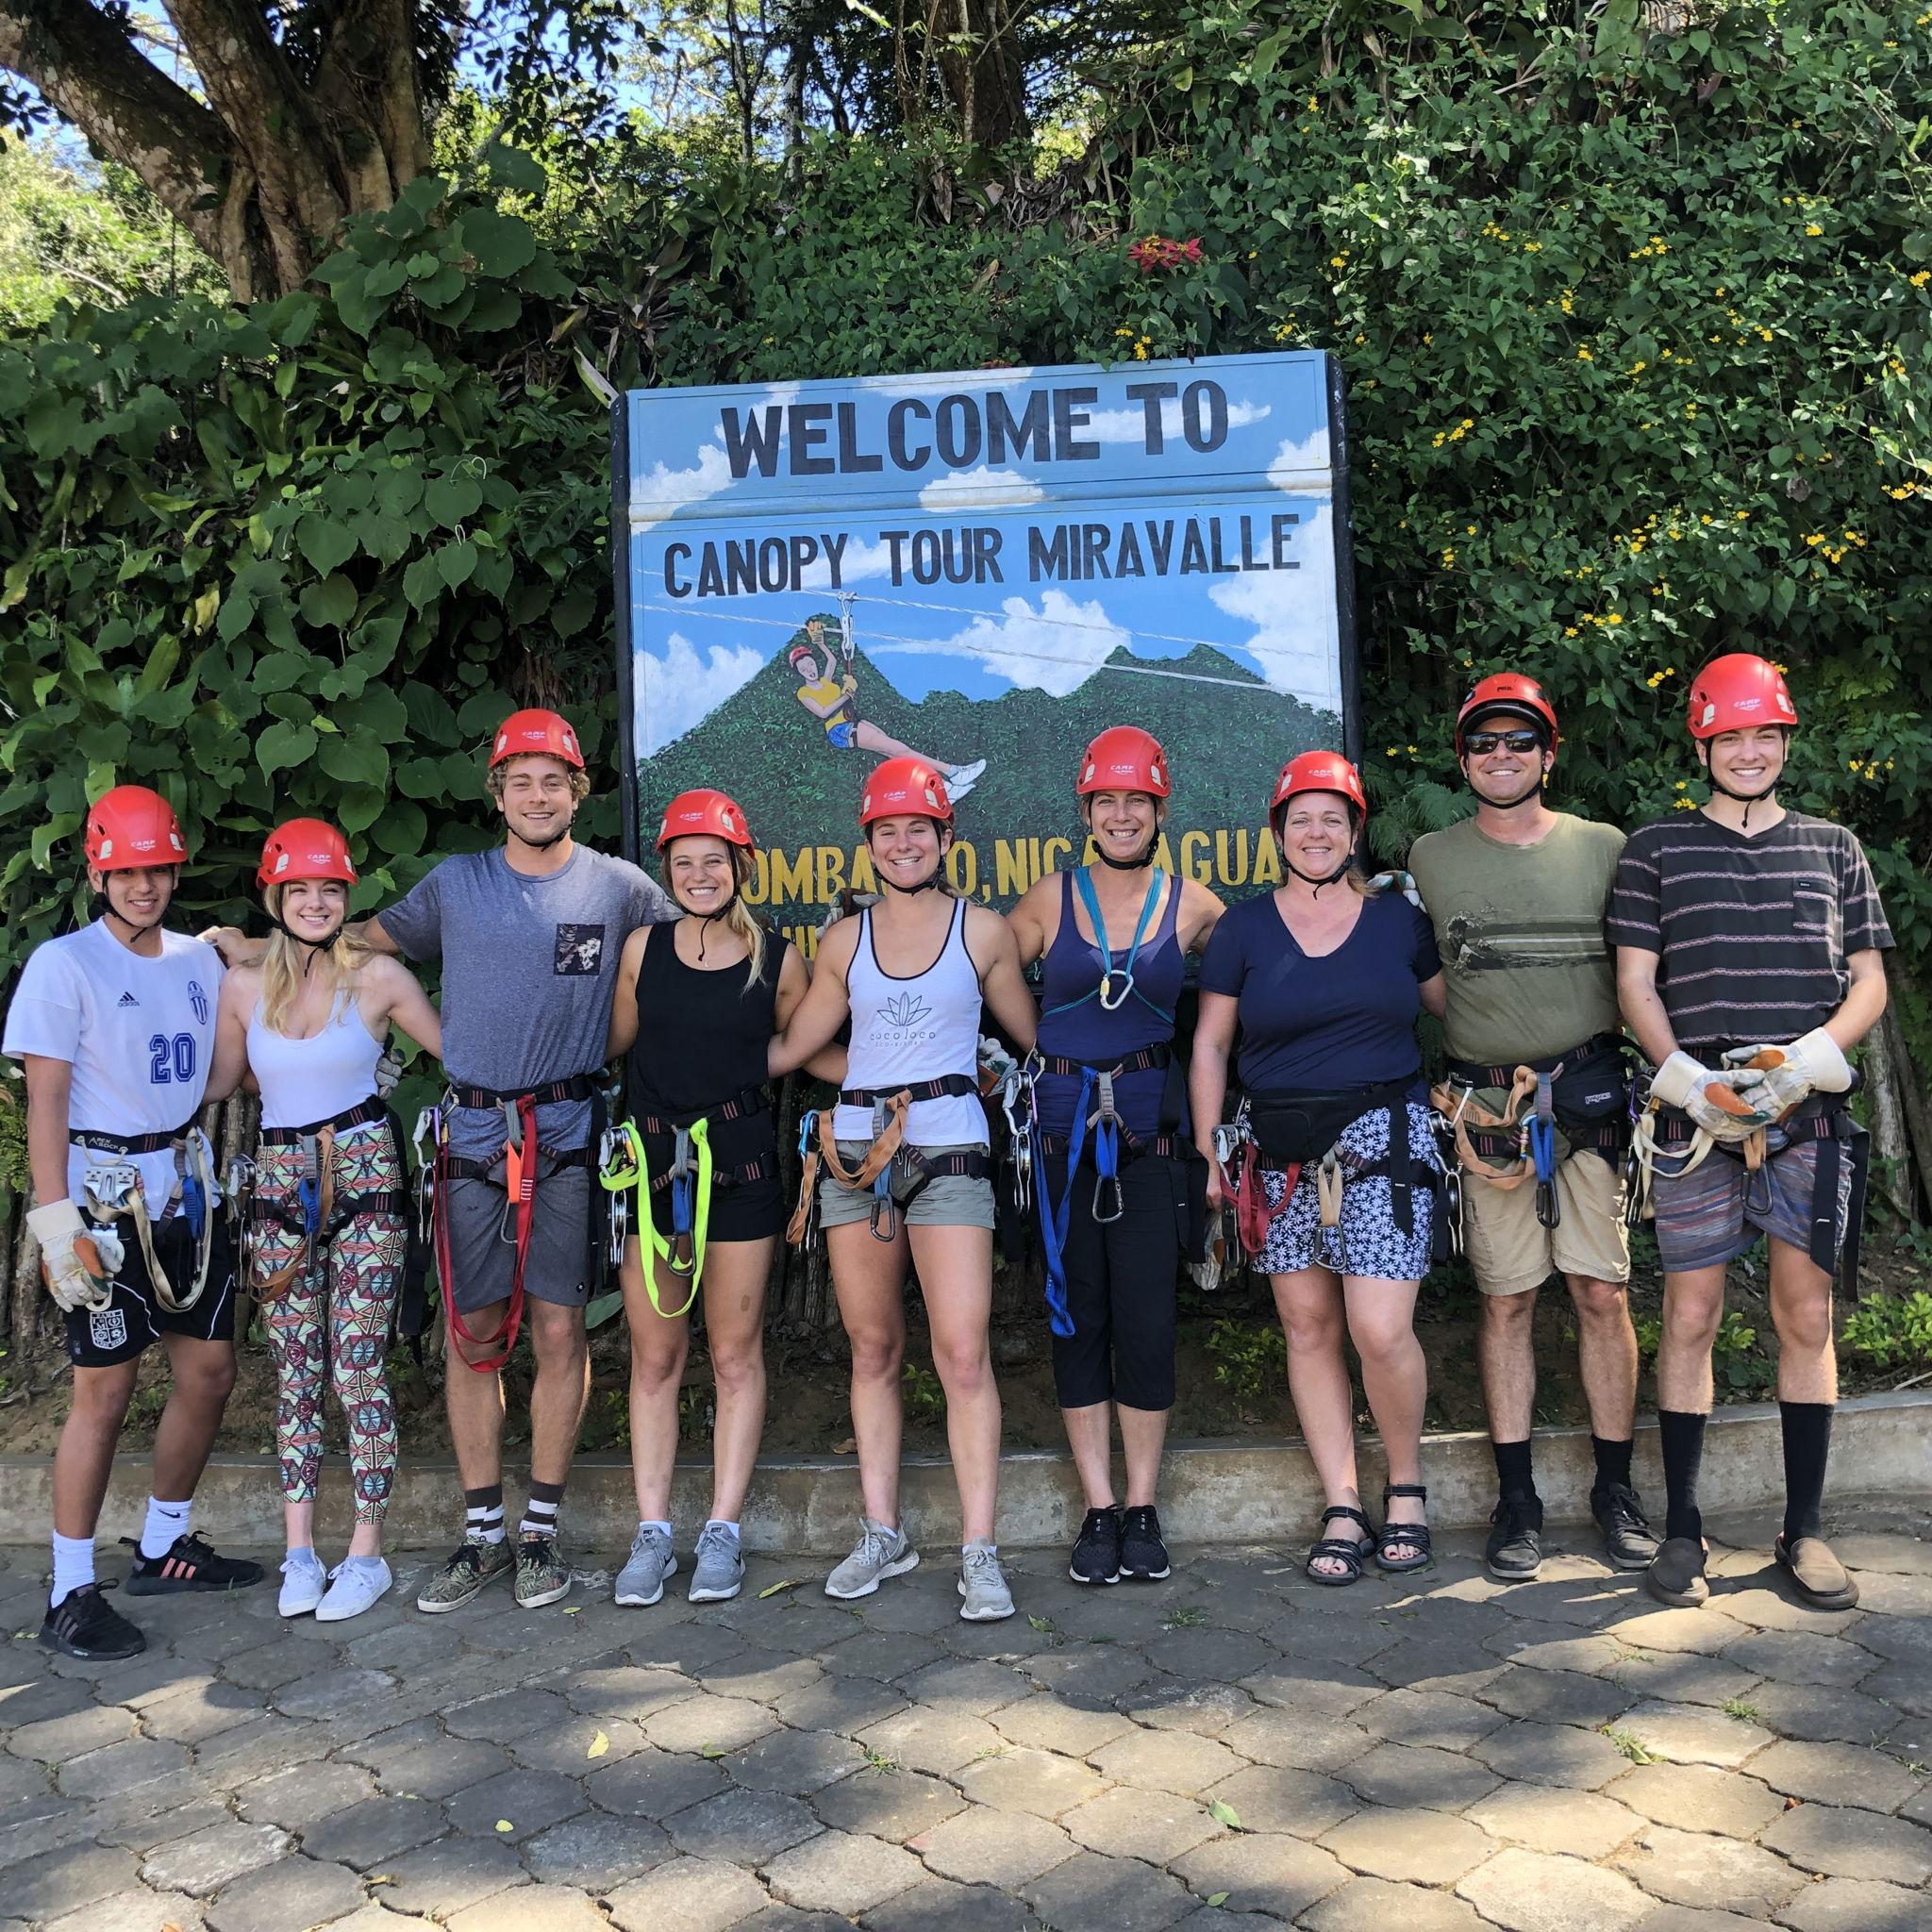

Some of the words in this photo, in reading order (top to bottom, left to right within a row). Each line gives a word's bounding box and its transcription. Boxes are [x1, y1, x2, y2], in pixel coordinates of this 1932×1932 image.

[721, 387, 1100, 479] WELCOME
[1125, 379, 1228, 456] TO
[664, 533, 849, 598] CANOPY
[879, 526, 1004, 587] TOUR
[1029, 514, 1300, 582] MIRAVALLE
[741, 841, 991, 906] OMBAO,
[994, 827, 1281, 896] NICAGUA
[149, 1032, 196, 1084] 20
[869, 1032, 901, 1041] coco
[905, 1027, 936, 1040] loco
